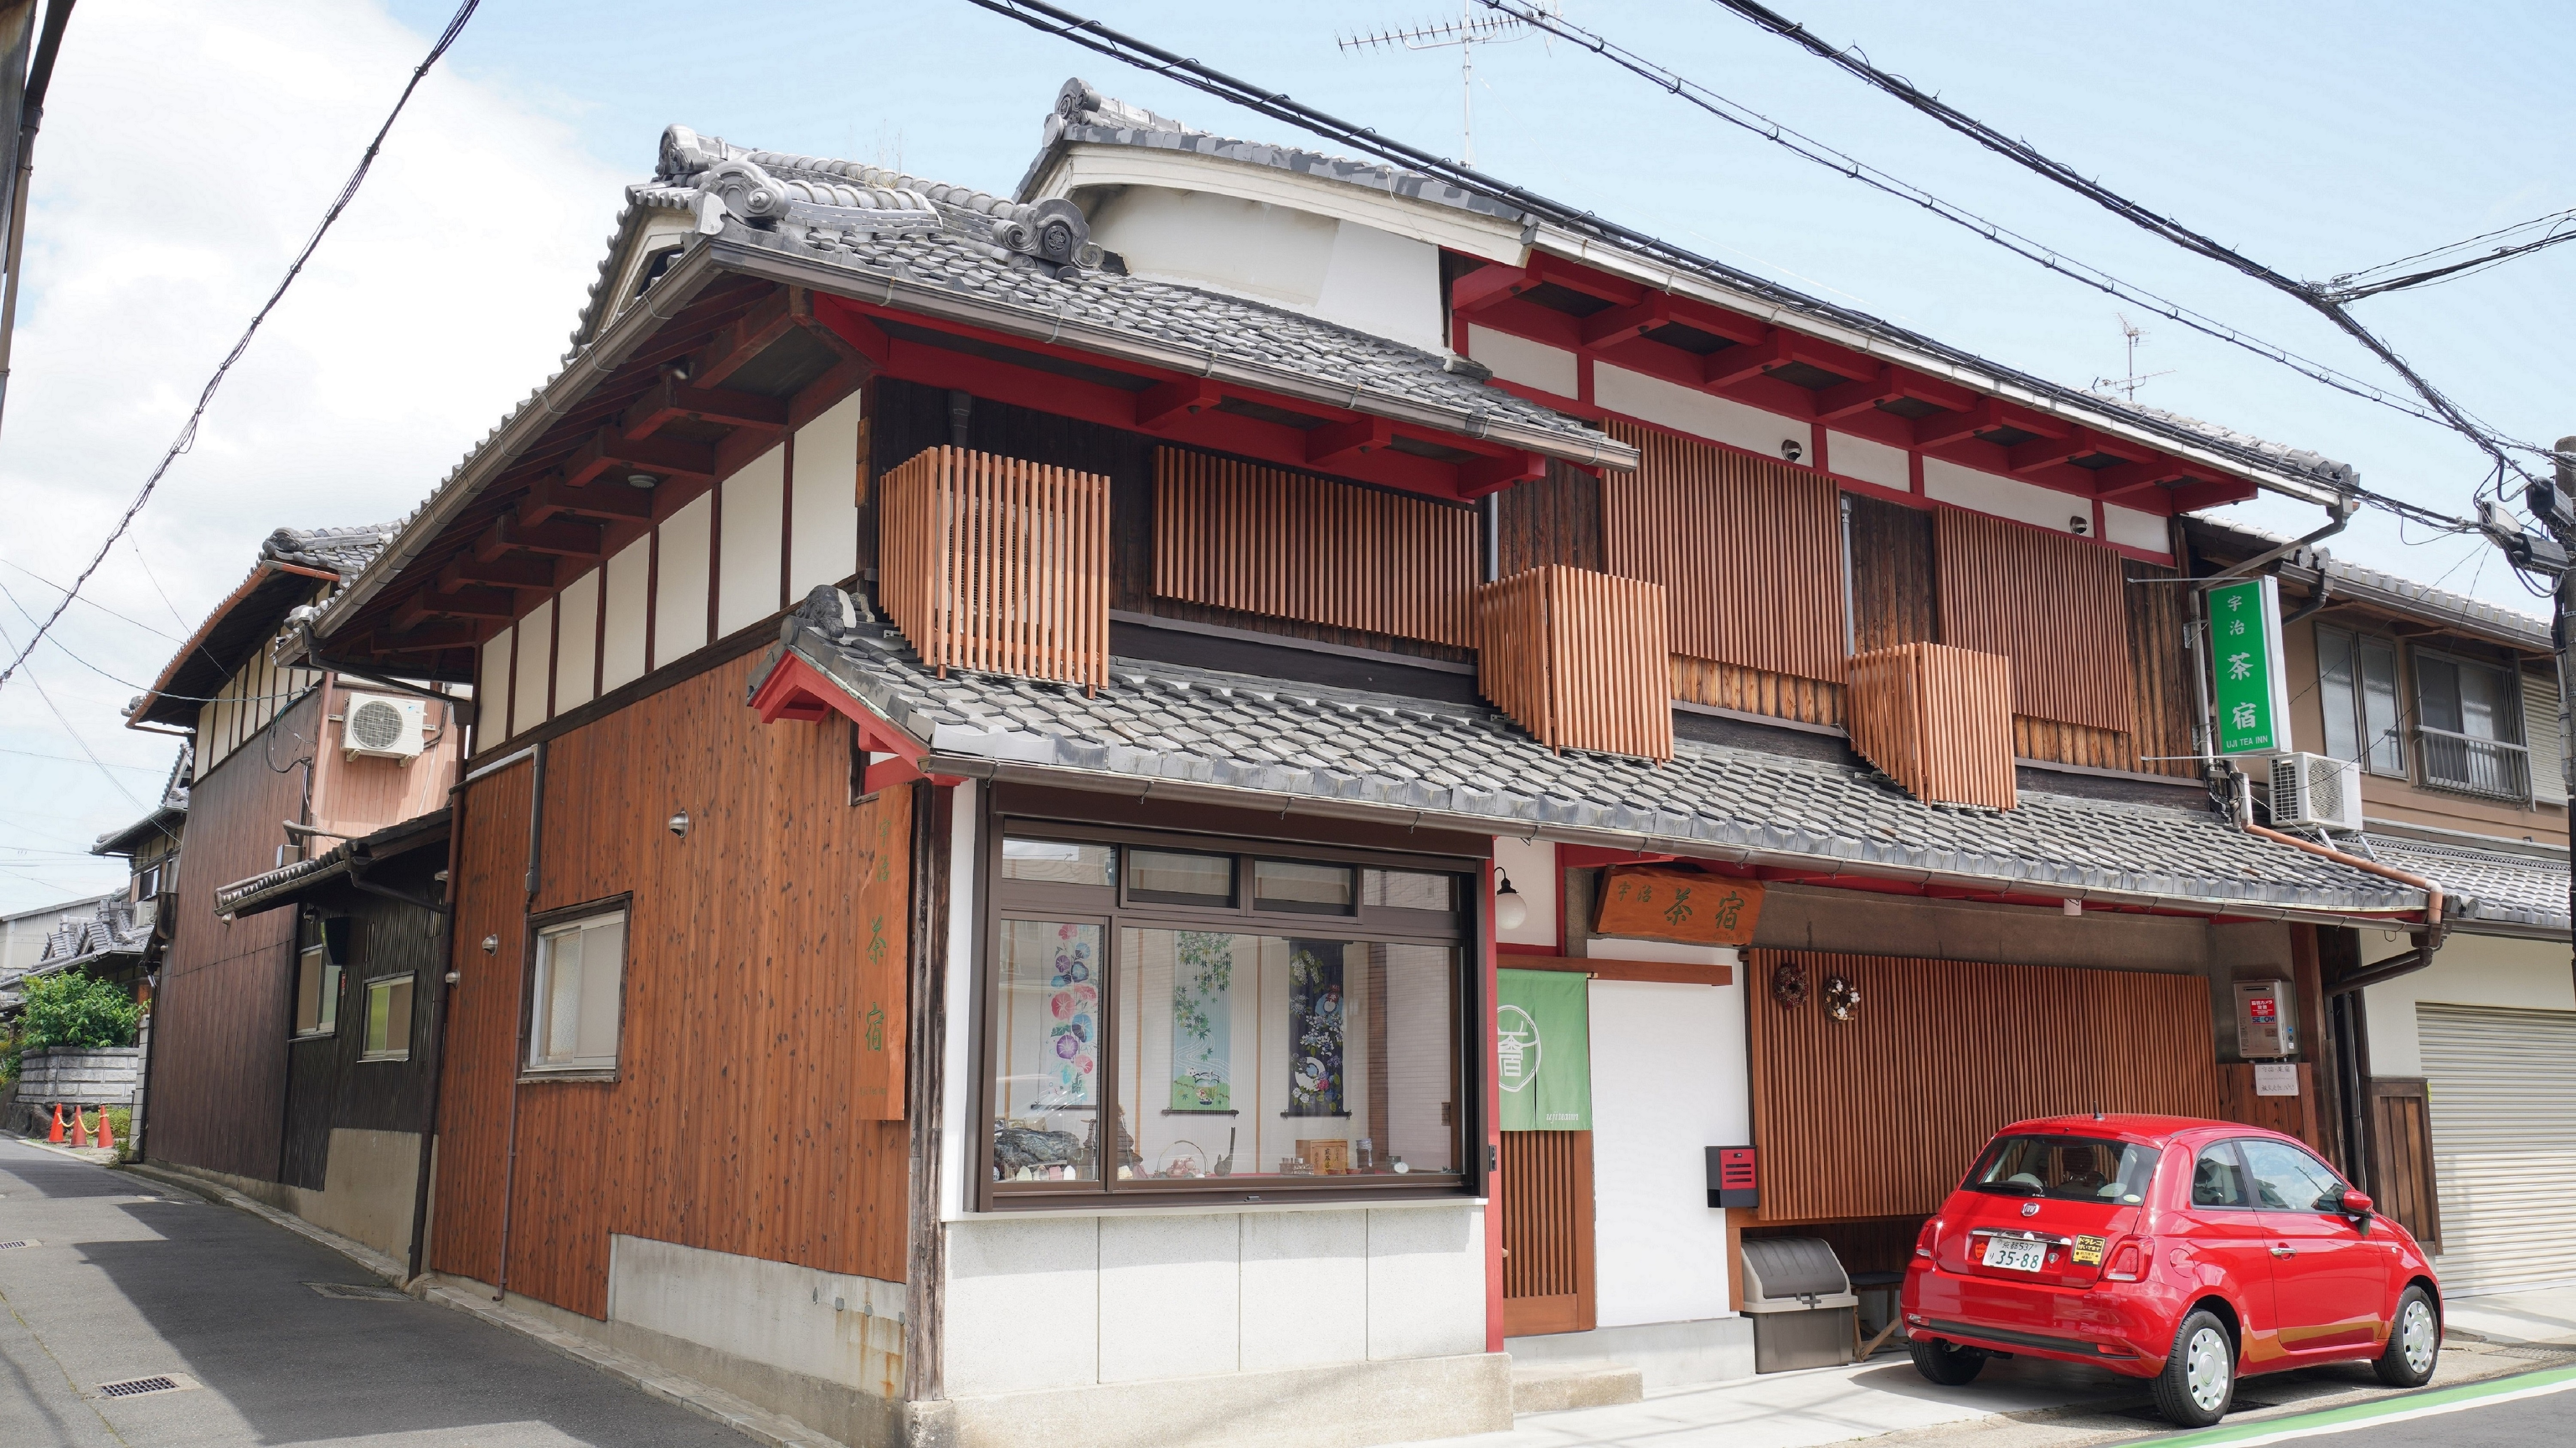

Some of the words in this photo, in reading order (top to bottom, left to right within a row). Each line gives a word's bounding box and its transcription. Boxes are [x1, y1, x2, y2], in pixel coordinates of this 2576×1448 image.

[2227, 740, 2238, 748] UJI
[2239, 738, 2253, 746] TEA
[2256, 735, 2268, 744] INN
[2078, 1237, 2103, 1246] ドラレコ
[1995, 1250, 2039, 1269] 35-88
